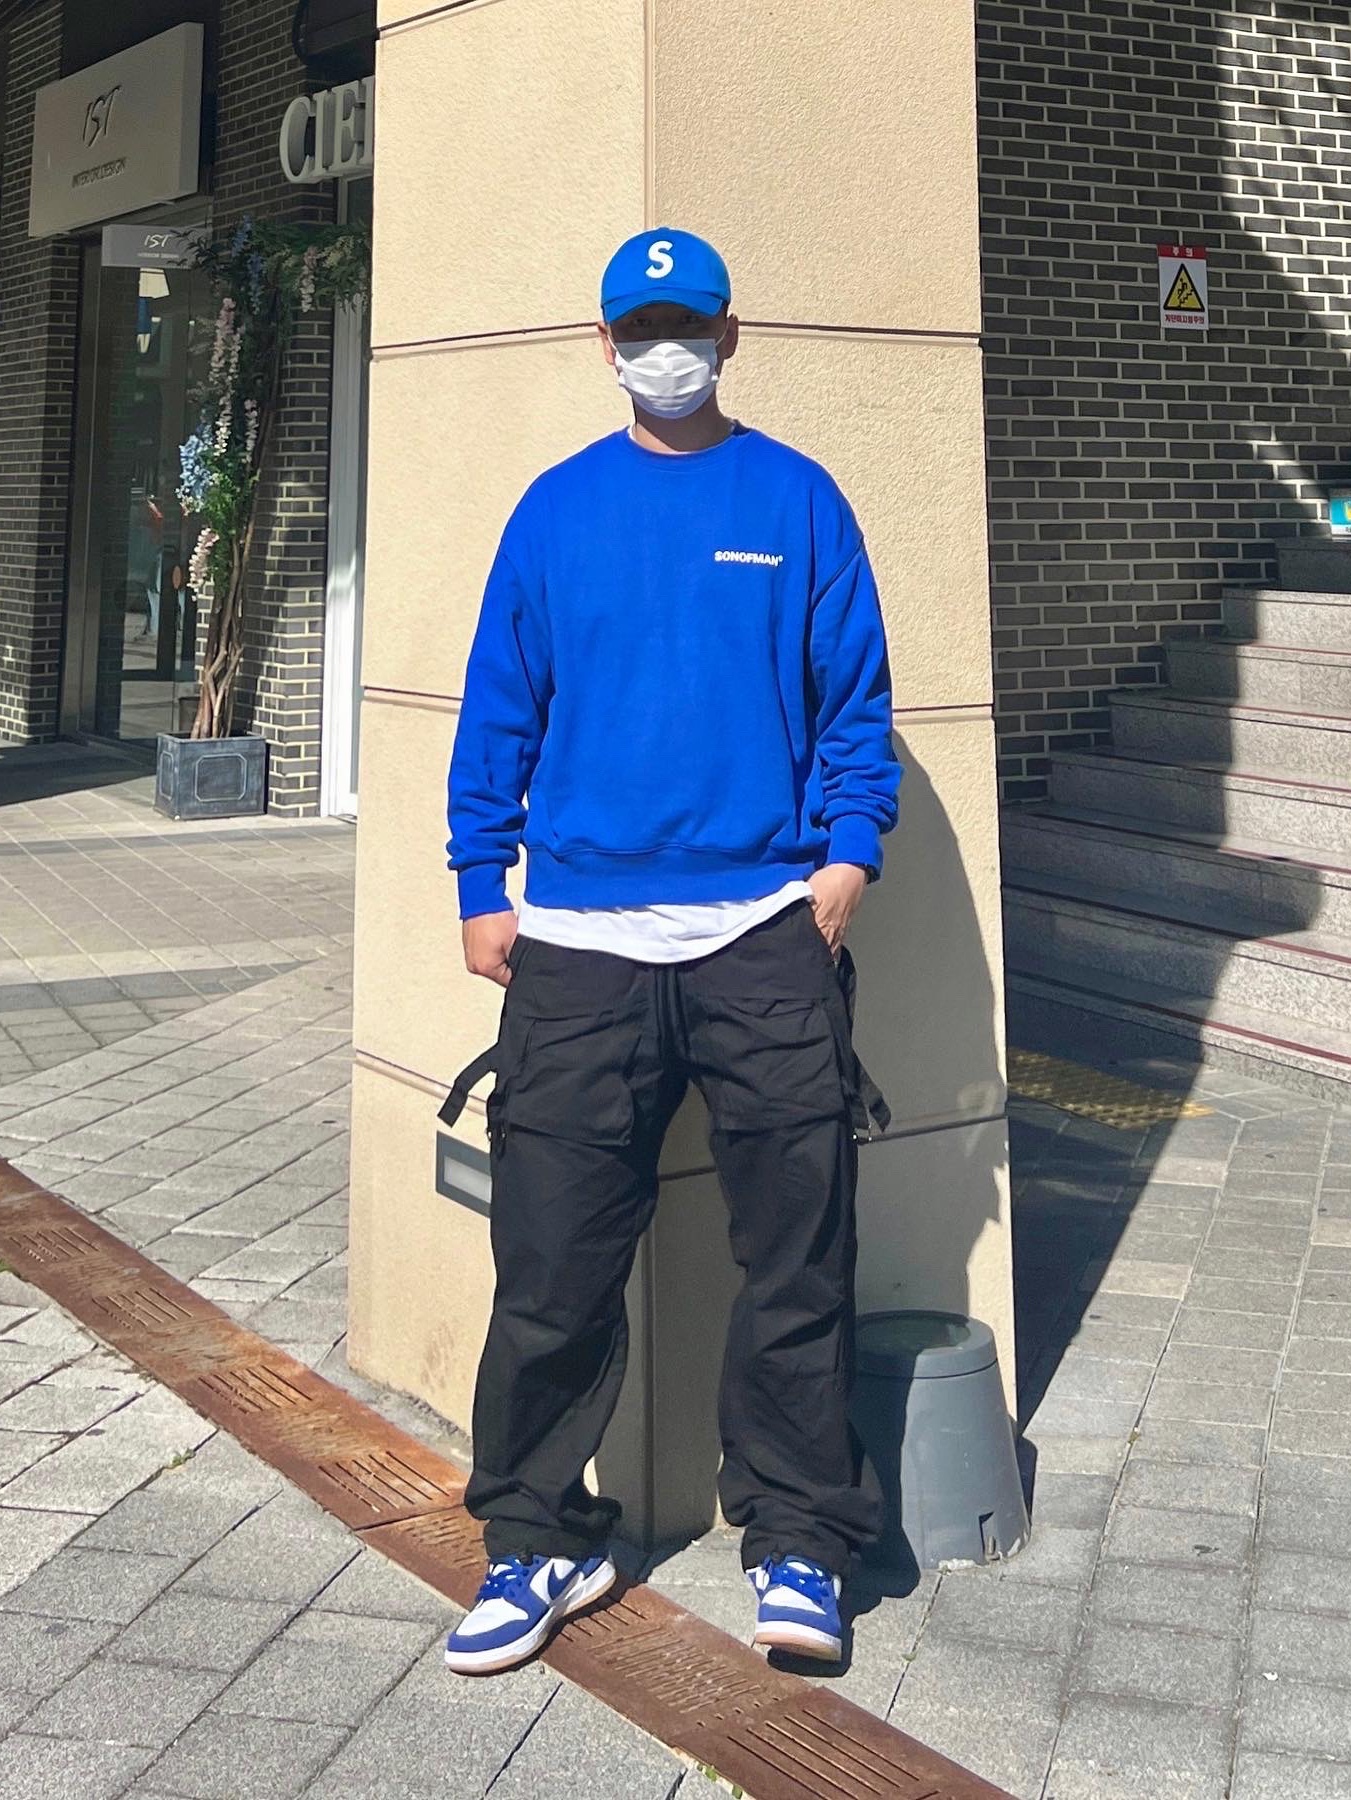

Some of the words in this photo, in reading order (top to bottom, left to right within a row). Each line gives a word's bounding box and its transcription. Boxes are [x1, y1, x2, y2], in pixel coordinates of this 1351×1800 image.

[280, 75, 375, 183] CIE
[144, 234, 174, 248] IST
[645, 240, 674, 279] S
